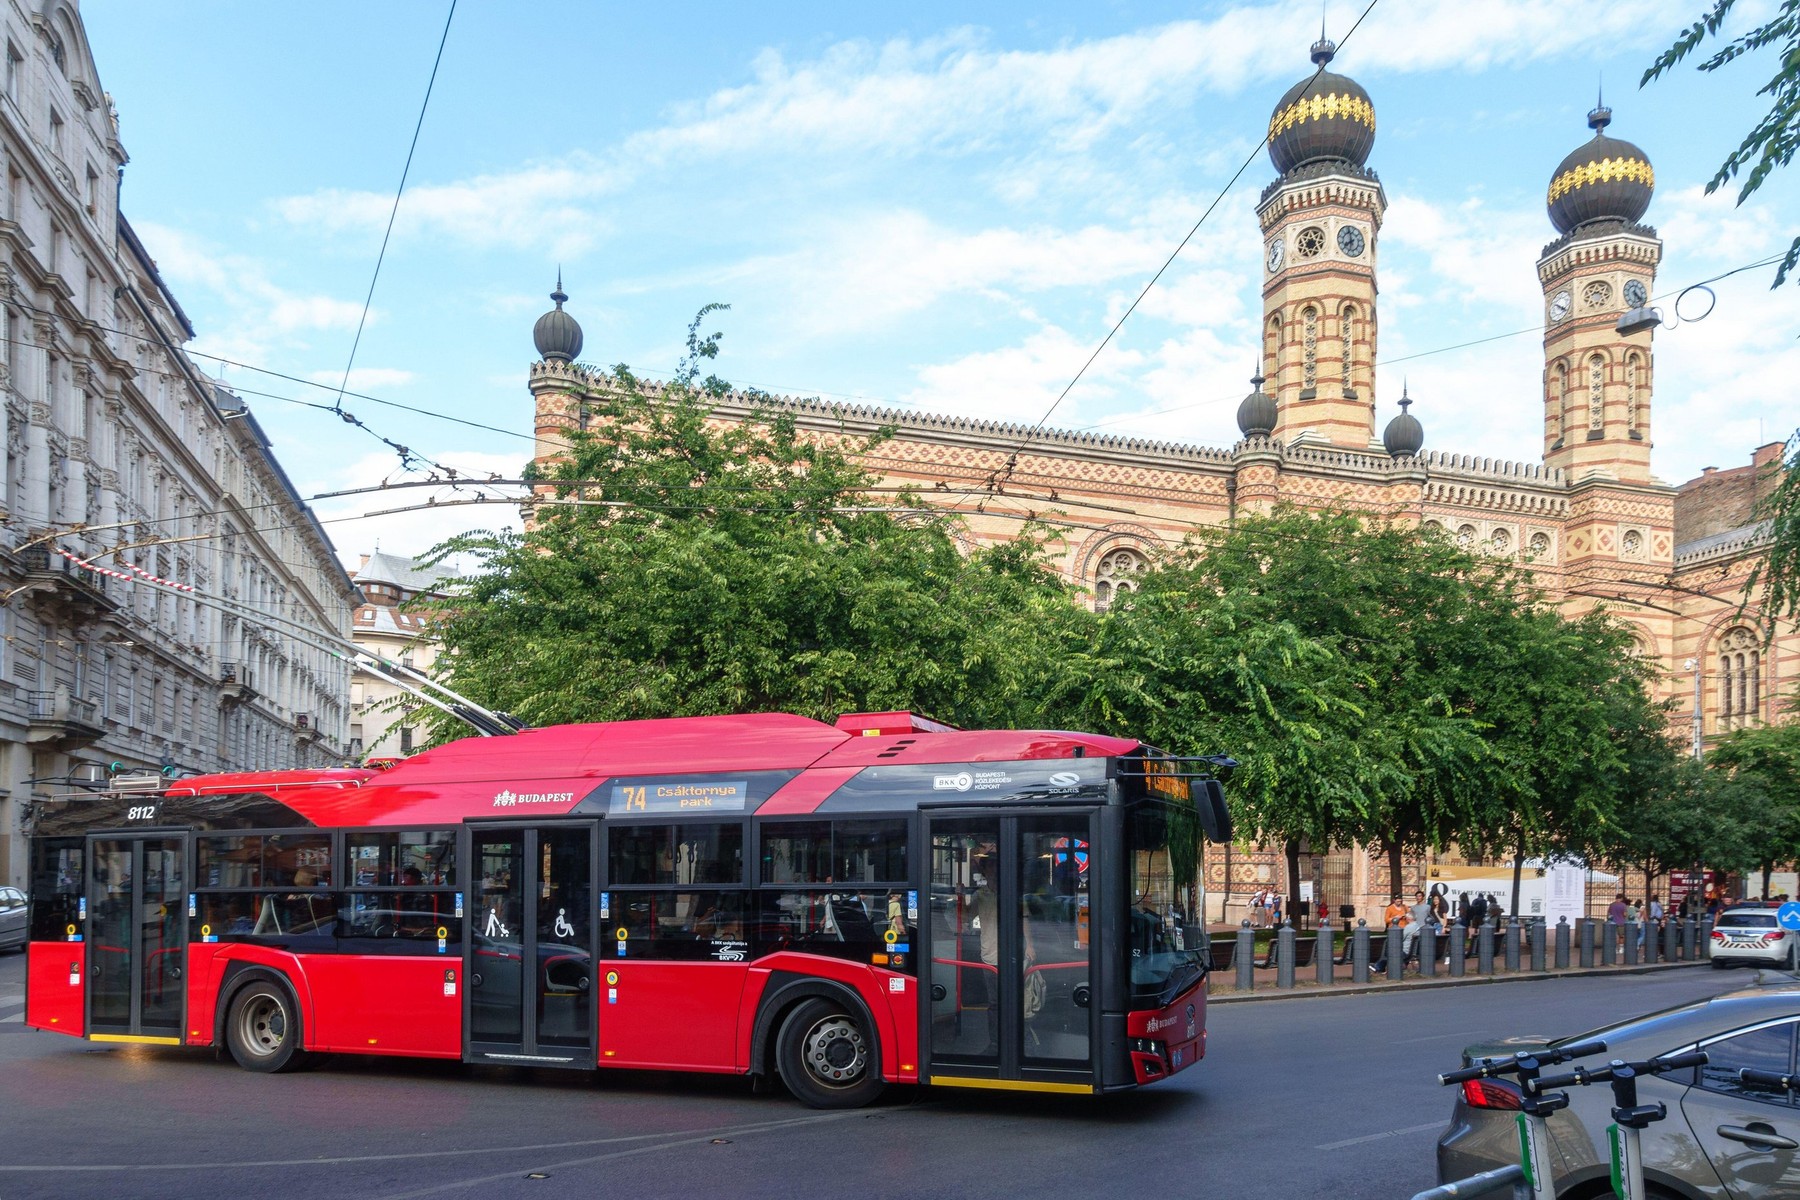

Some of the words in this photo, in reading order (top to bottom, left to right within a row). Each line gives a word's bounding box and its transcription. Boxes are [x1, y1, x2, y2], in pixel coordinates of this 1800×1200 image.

[518, 792, 573, 803] BUDAPEST
[623, 786, 646, 811] 74
[657, 785, 736, 797] Csáktornya
[680, 796, 712, 808] park
[128, 806, 155, 820] 8112
